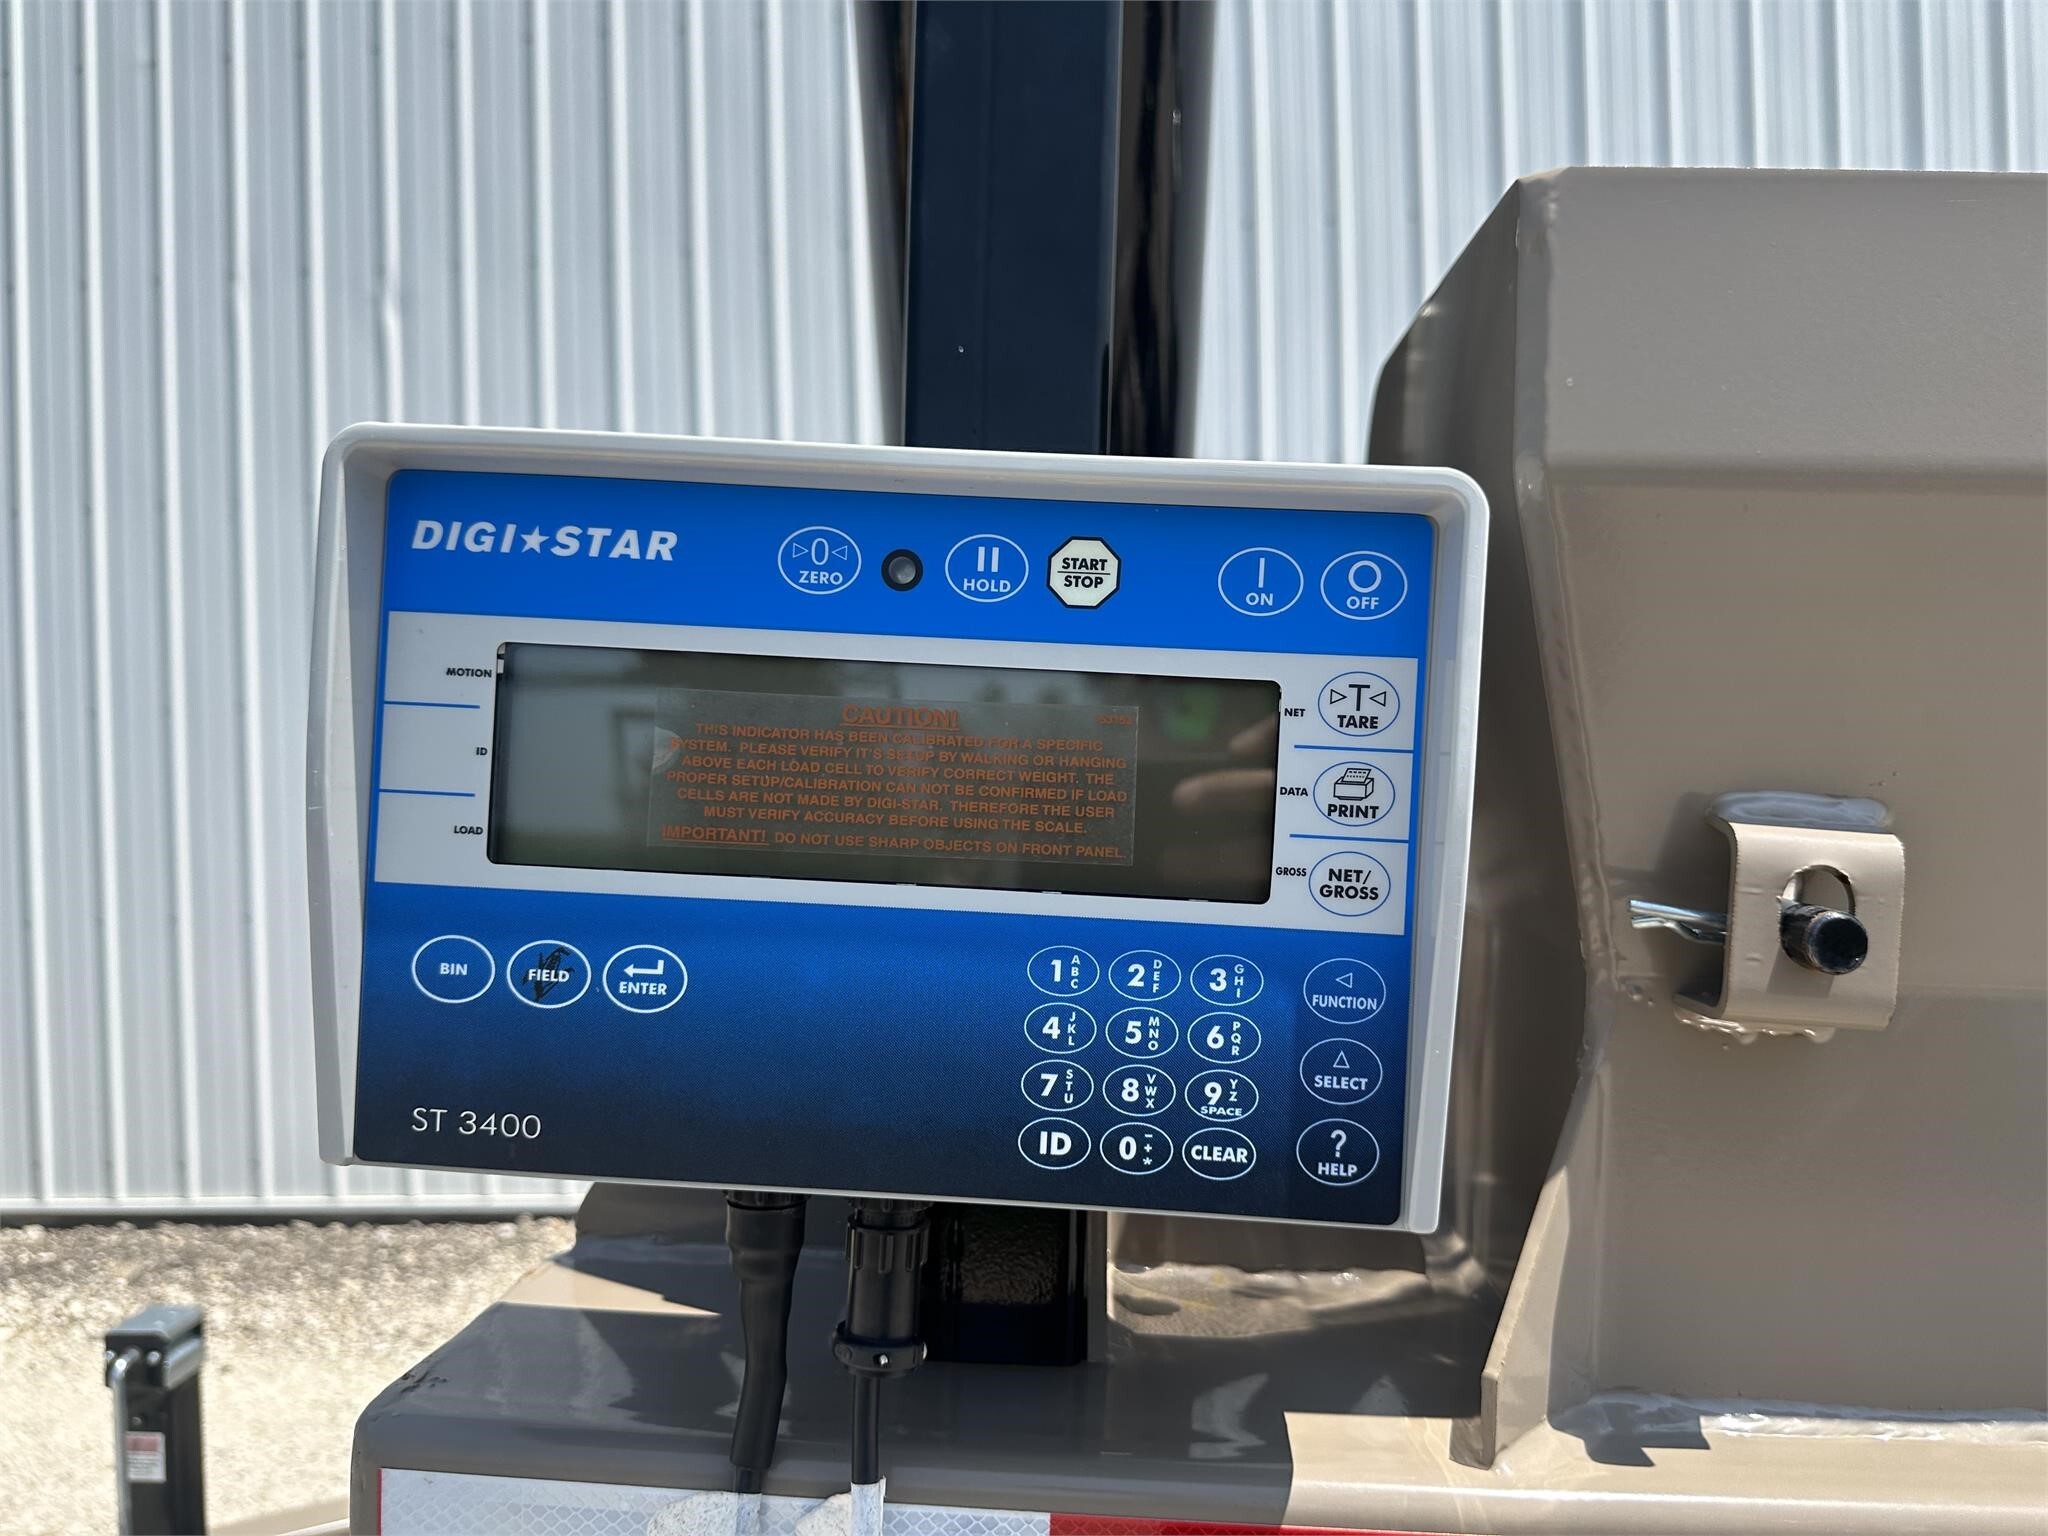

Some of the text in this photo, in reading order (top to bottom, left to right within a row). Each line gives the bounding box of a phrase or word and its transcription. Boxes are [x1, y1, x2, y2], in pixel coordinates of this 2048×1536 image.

[1062, 557, 1108, 571] START
[799, 570, 843, 586] ZERO
[963, 578, 1011, 593] HOLD
[1063, 575, 1104, 589] STOP
[1246, 592, 1273, 606] ON
[1346, 596, 1379, 610] OFF
[446, 667, 492, 678] MOTION
[1348, 684, 1370, 711] T
[841, 703, 959, 728] CAUTION!
[1284, 708, 1305, 717] NET
[1337, 714, 1379, 729] TARE
[696, 723, 1104, 751] THIS INDICATOR HAS BEEN CALIBRATED FOR A SPECIFIC
[476, 747, 488, 756] ID
[671, 737, 1127, 769] SYSTEM. PLEASE VERIFY IT'S SETUP BY WALKING OR HANGING
[681, 755, 1115, 785] ABOVE EACH LOAD CELL TO VERIFY CORRECT WEIGHT. THE
[666, 771, 1128, 802] PROPER SETUP/CALIBRATION CAN NOT BE CONFIRMED IF LOAD
[1279, 786, 1308, 797] DATA
[677, 788, 1115, 818] CELLS ARE NOT MADE BY DIGI-STAR. THEREFORE THE USER
[1327, 803, 1379, 819] PRINT
[703, 806, 1088, 834] MUST VERIFY ACCURACY BEFORE USING THE SCALE.
[453, 825, 483, 835] LOAD
[660, 824, 1127, 858] IMPORTANT! DO NOT USE SHARP OBJECTS ON FRONT PANEL.
[1275, 866, 1307, 877] GROSS
[1328, 868, 1371, 885] NET/
[1319, 884, 1379, 900] GROSS
[440, 962, 468, 976] BIN
[528, 968, 569, 983] FIELD
[1050, 959, 1062, 982] 1
[1127, 963, 1145, 987] 2
[618, 981, 667, 996] ENTER
[1209, 968, 1227, 992] 3
[1312, 994, 1377, 1010] FUNCTION
[1042, 1016, 1061, 1039] 4
[1125, 1020, 1142, 1044] 5
[1206, 1025, 1224, 1049] 6
[1040, 1073, 1058, 1096] 7
[1121, 1078, 1139, 1102] 8
[1314, 1075, 1368, 1090] SELECT
[1204, 1081, 1222, 1105] 9
[1200, 1106, 1242, 1116] SPACE
[411, 1107, 542, 1139] ST 3400
[1039, 1131, 1072, 1155] ID
[1119, 1136, 1137, 1160] 0
[1190, 1145, 1248, 1163] CLEAR
[1317, 1162, 1358, 1177] HELP
